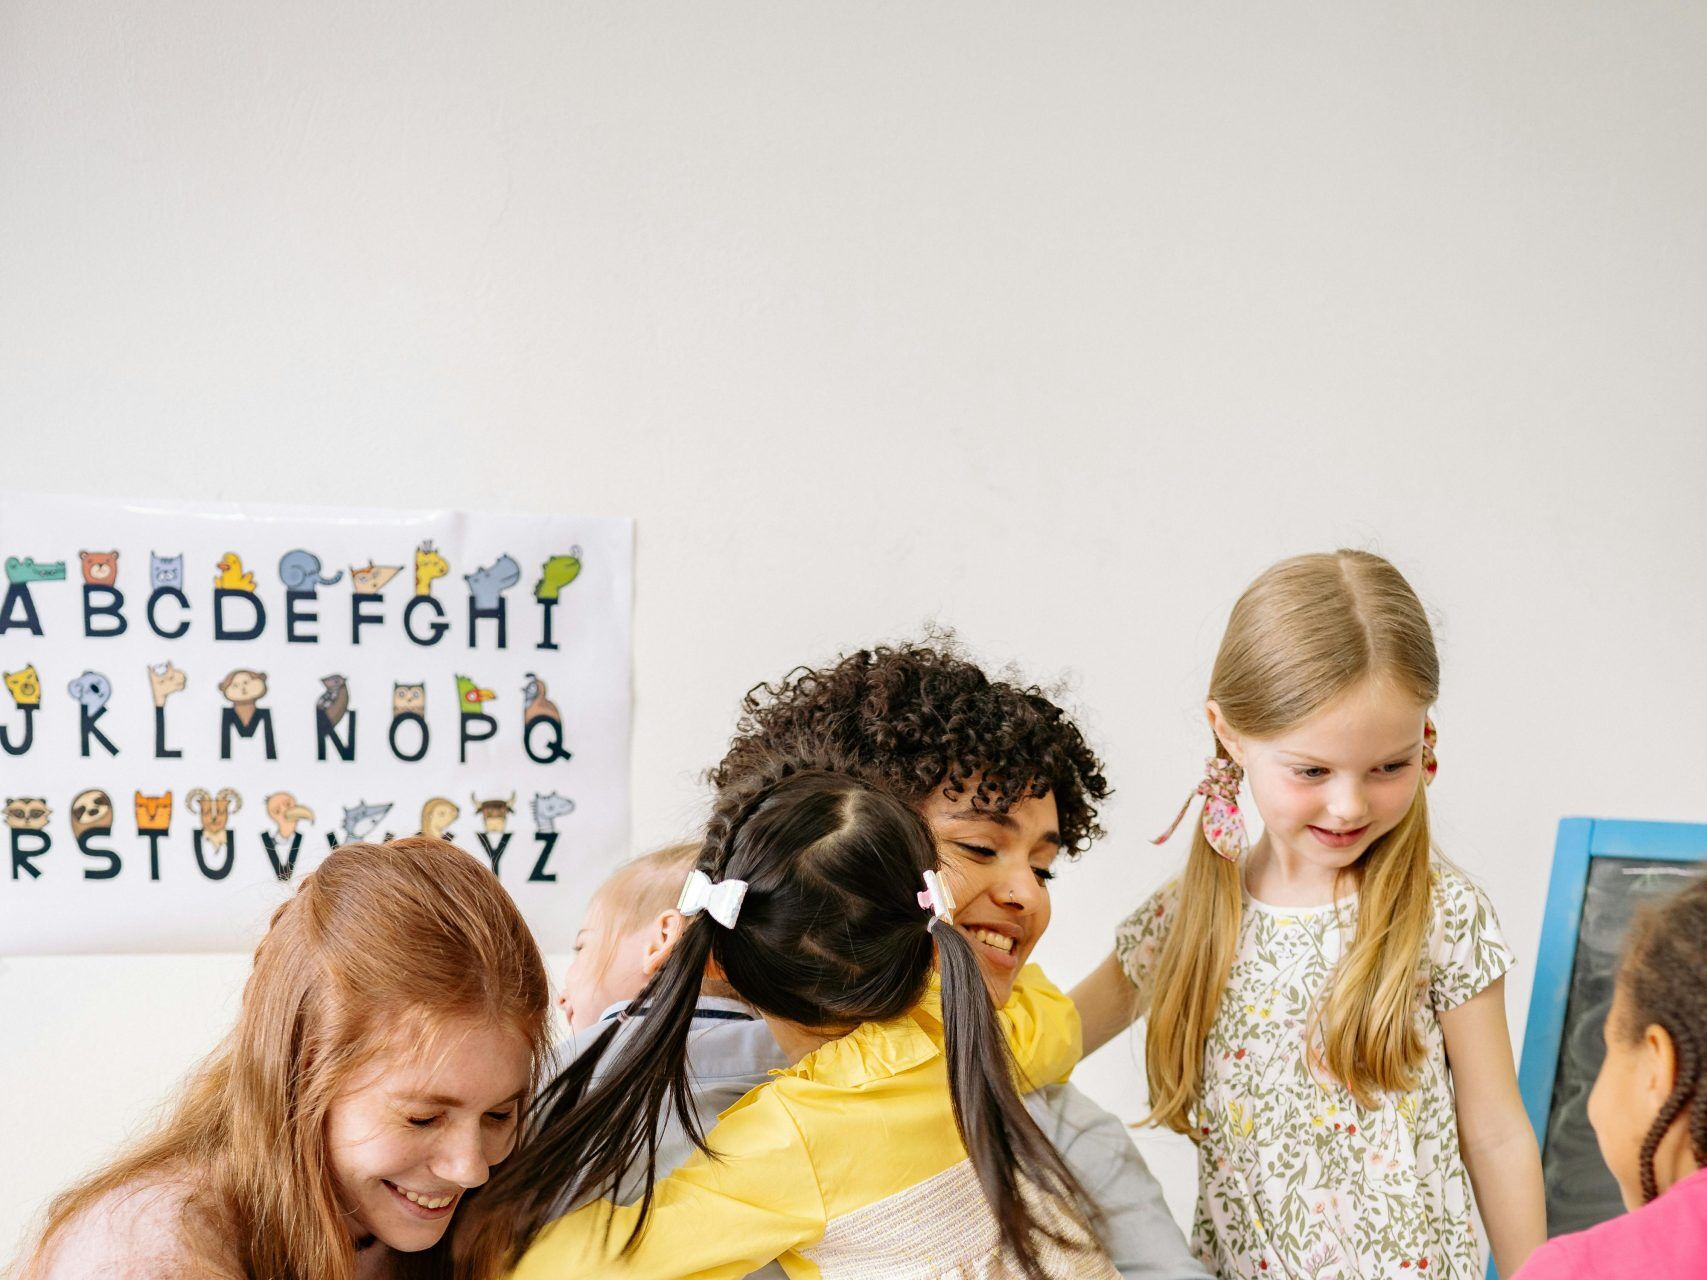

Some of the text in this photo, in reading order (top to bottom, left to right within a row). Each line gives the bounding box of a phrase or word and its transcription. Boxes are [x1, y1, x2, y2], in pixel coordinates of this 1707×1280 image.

[0, 582, 558, 649] A B C D E F G H I
[0, 703, 571, 763] J K L M N O P Q
[11, 826, 558, 881] R S T U V Y Z
